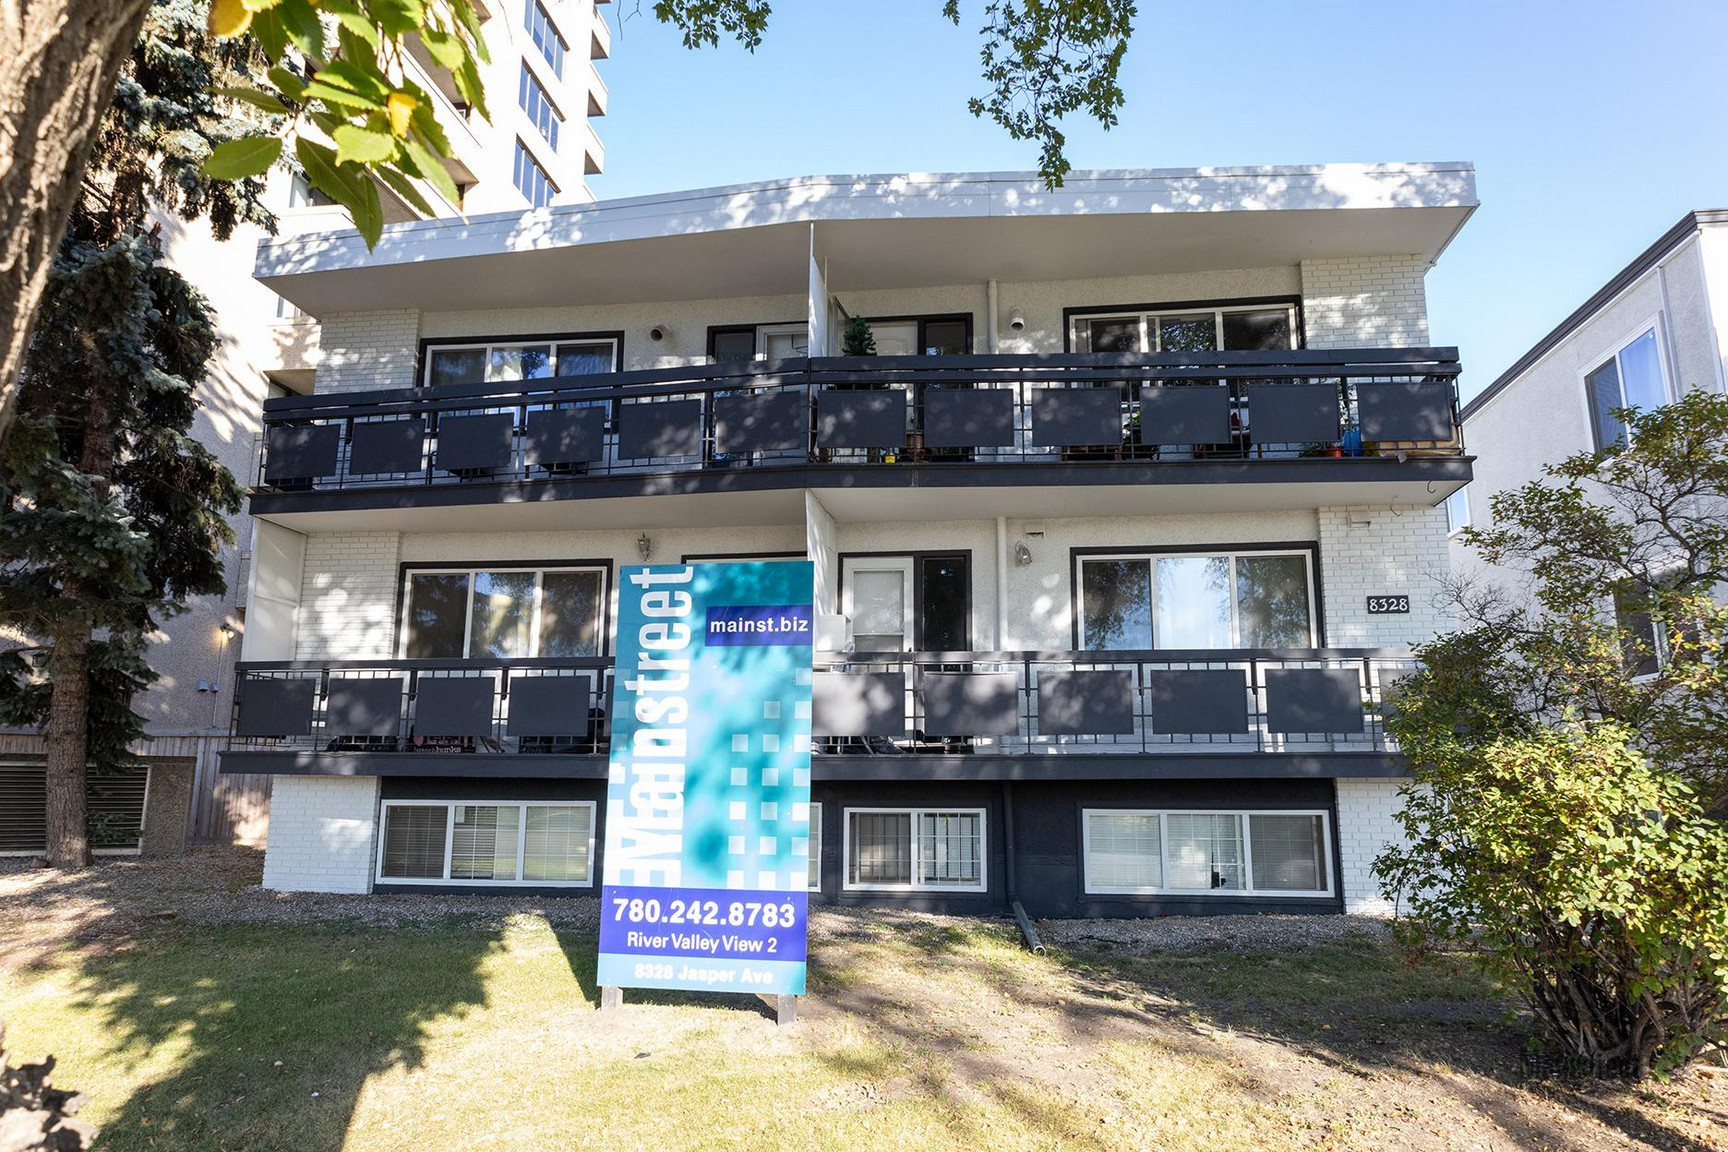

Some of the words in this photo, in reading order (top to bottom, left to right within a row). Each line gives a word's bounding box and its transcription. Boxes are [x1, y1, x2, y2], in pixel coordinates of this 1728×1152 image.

[1369, 598, 1408, 611] 8328
[710, 616, 808, 632] mainst.biz
[616, 565, 694, 872] Mainstreet
[613, 898, 796, 928] 780.242.8783
[627, 931, 669, 948] River
[671, 933, 720, 954] Valley
[722, 935, 763, 952] View
[767, 938, 777, 953] 2
[634, 963, 674, 980] 8328
[678, 965, 736, 985] Jasper
[739, 968, 774, 985] Ave
